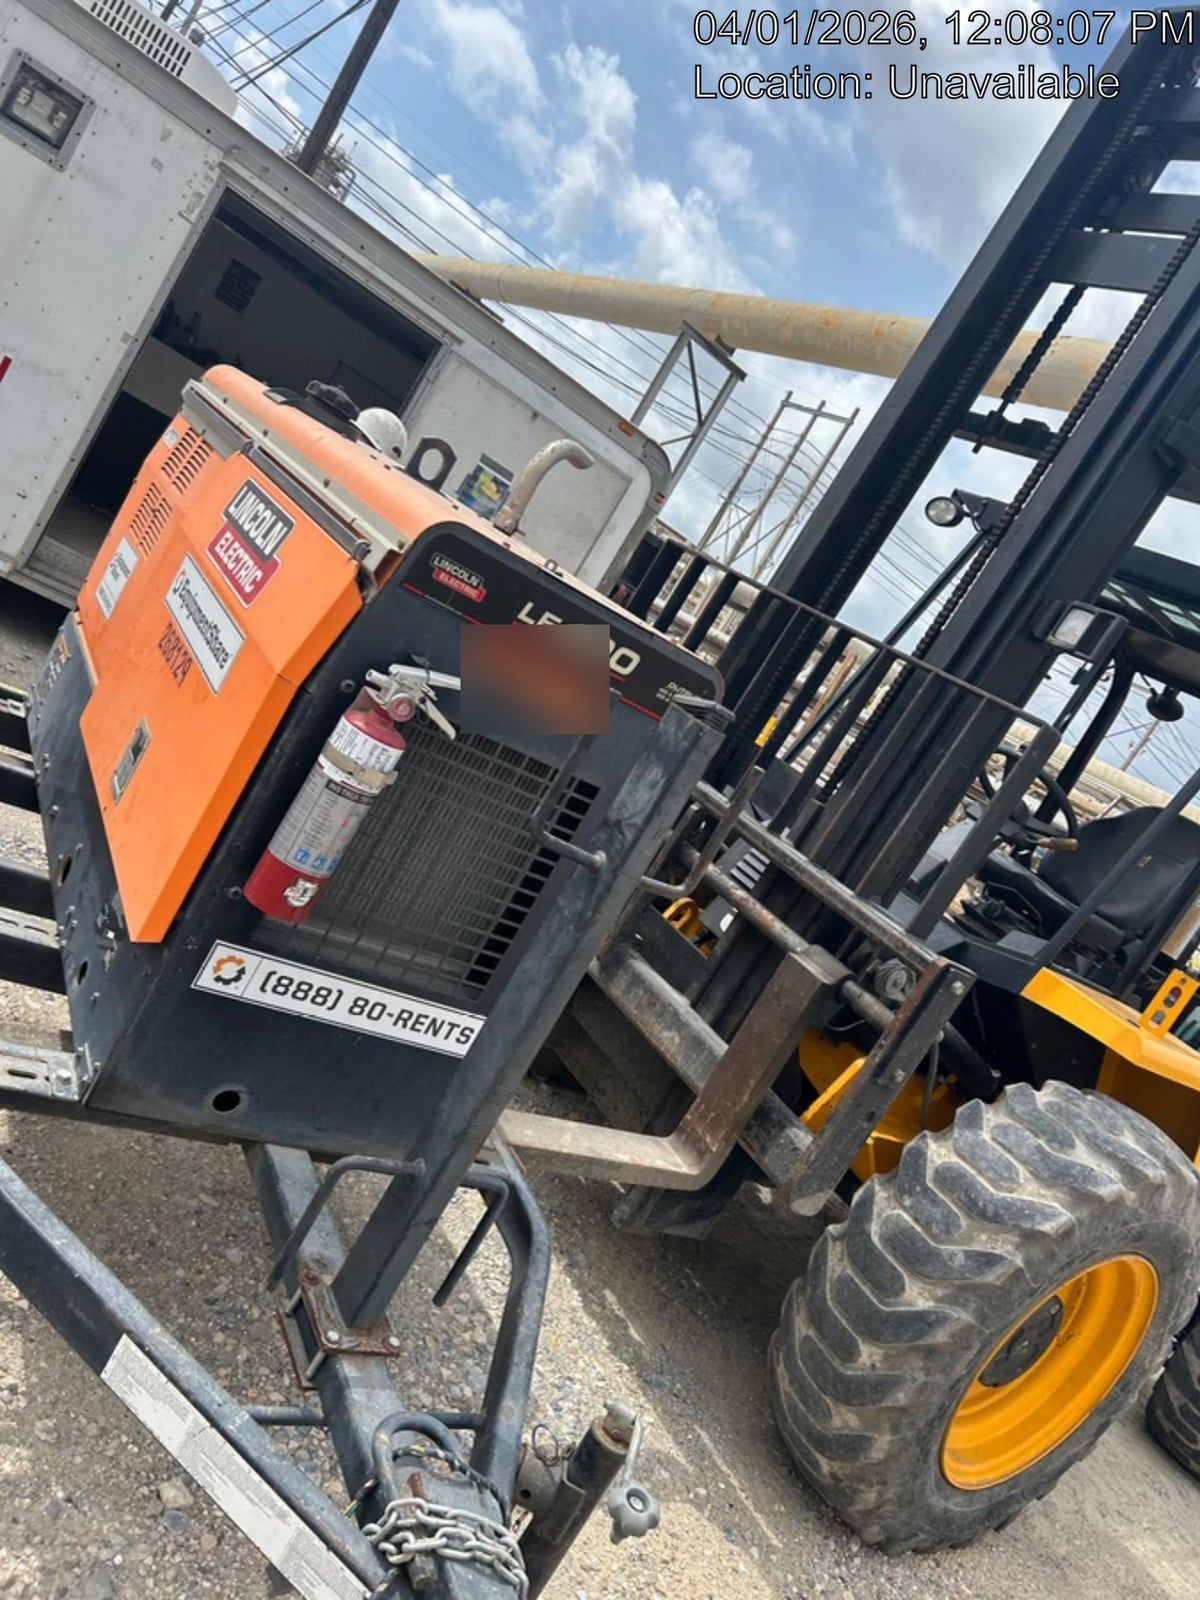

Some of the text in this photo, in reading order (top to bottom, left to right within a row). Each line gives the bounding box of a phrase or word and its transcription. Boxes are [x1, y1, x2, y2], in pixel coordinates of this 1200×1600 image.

[227, 486, 289, 556] LINCOLN
[214, 530, 264, 593] ELECTRIC
[432, 555, 481, 586] LINCOLN
[258, 969, 476, 1046] (888) 80-RENTS
